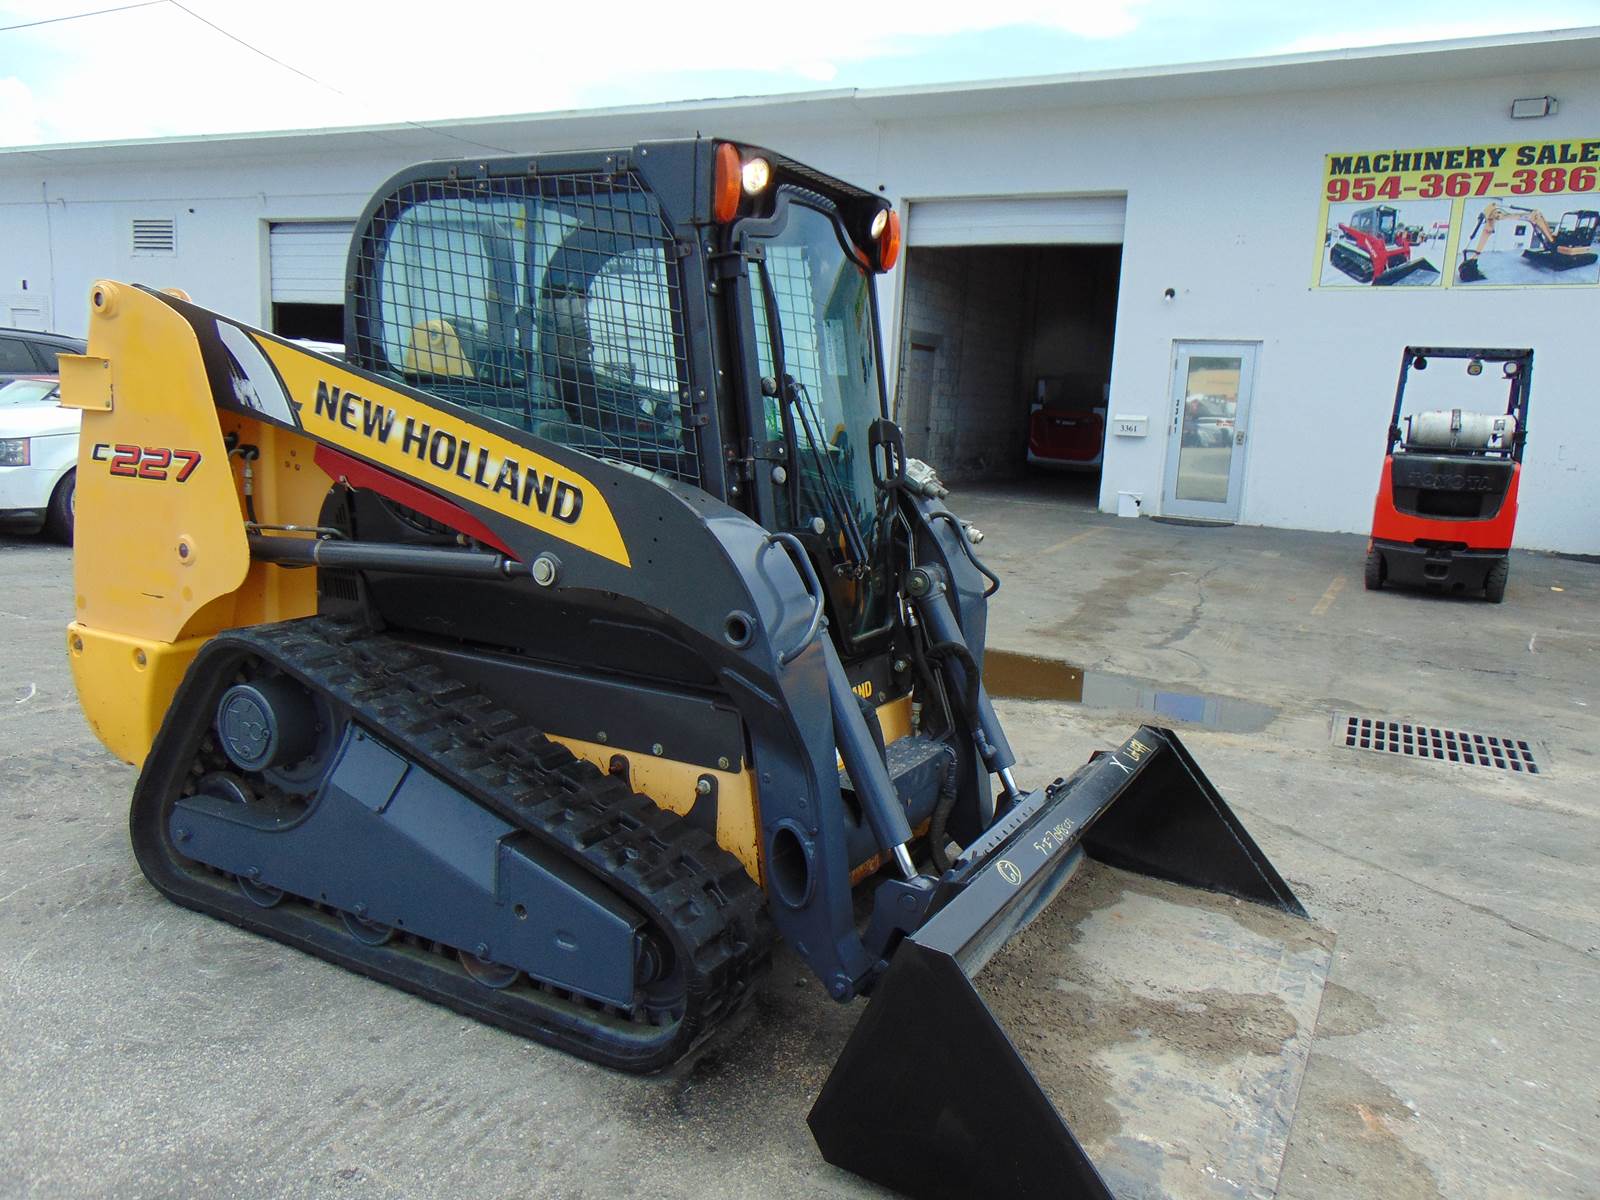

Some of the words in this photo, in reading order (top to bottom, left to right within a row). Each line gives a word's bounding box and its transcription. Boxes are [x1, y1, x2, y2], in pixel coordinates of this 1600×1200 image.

[1330, 147, 1506, 175] MACHINERY
[1516, 141, 1600, 166] SALE
[1327, 166, 1600, 202] 954-367-386
[1120, 424, 1137, 433] 3361
[92, 443, 202, 483] C227
[314, 379, 395, 443] NEW
[402, 414, 584, 525] HOLLAND
